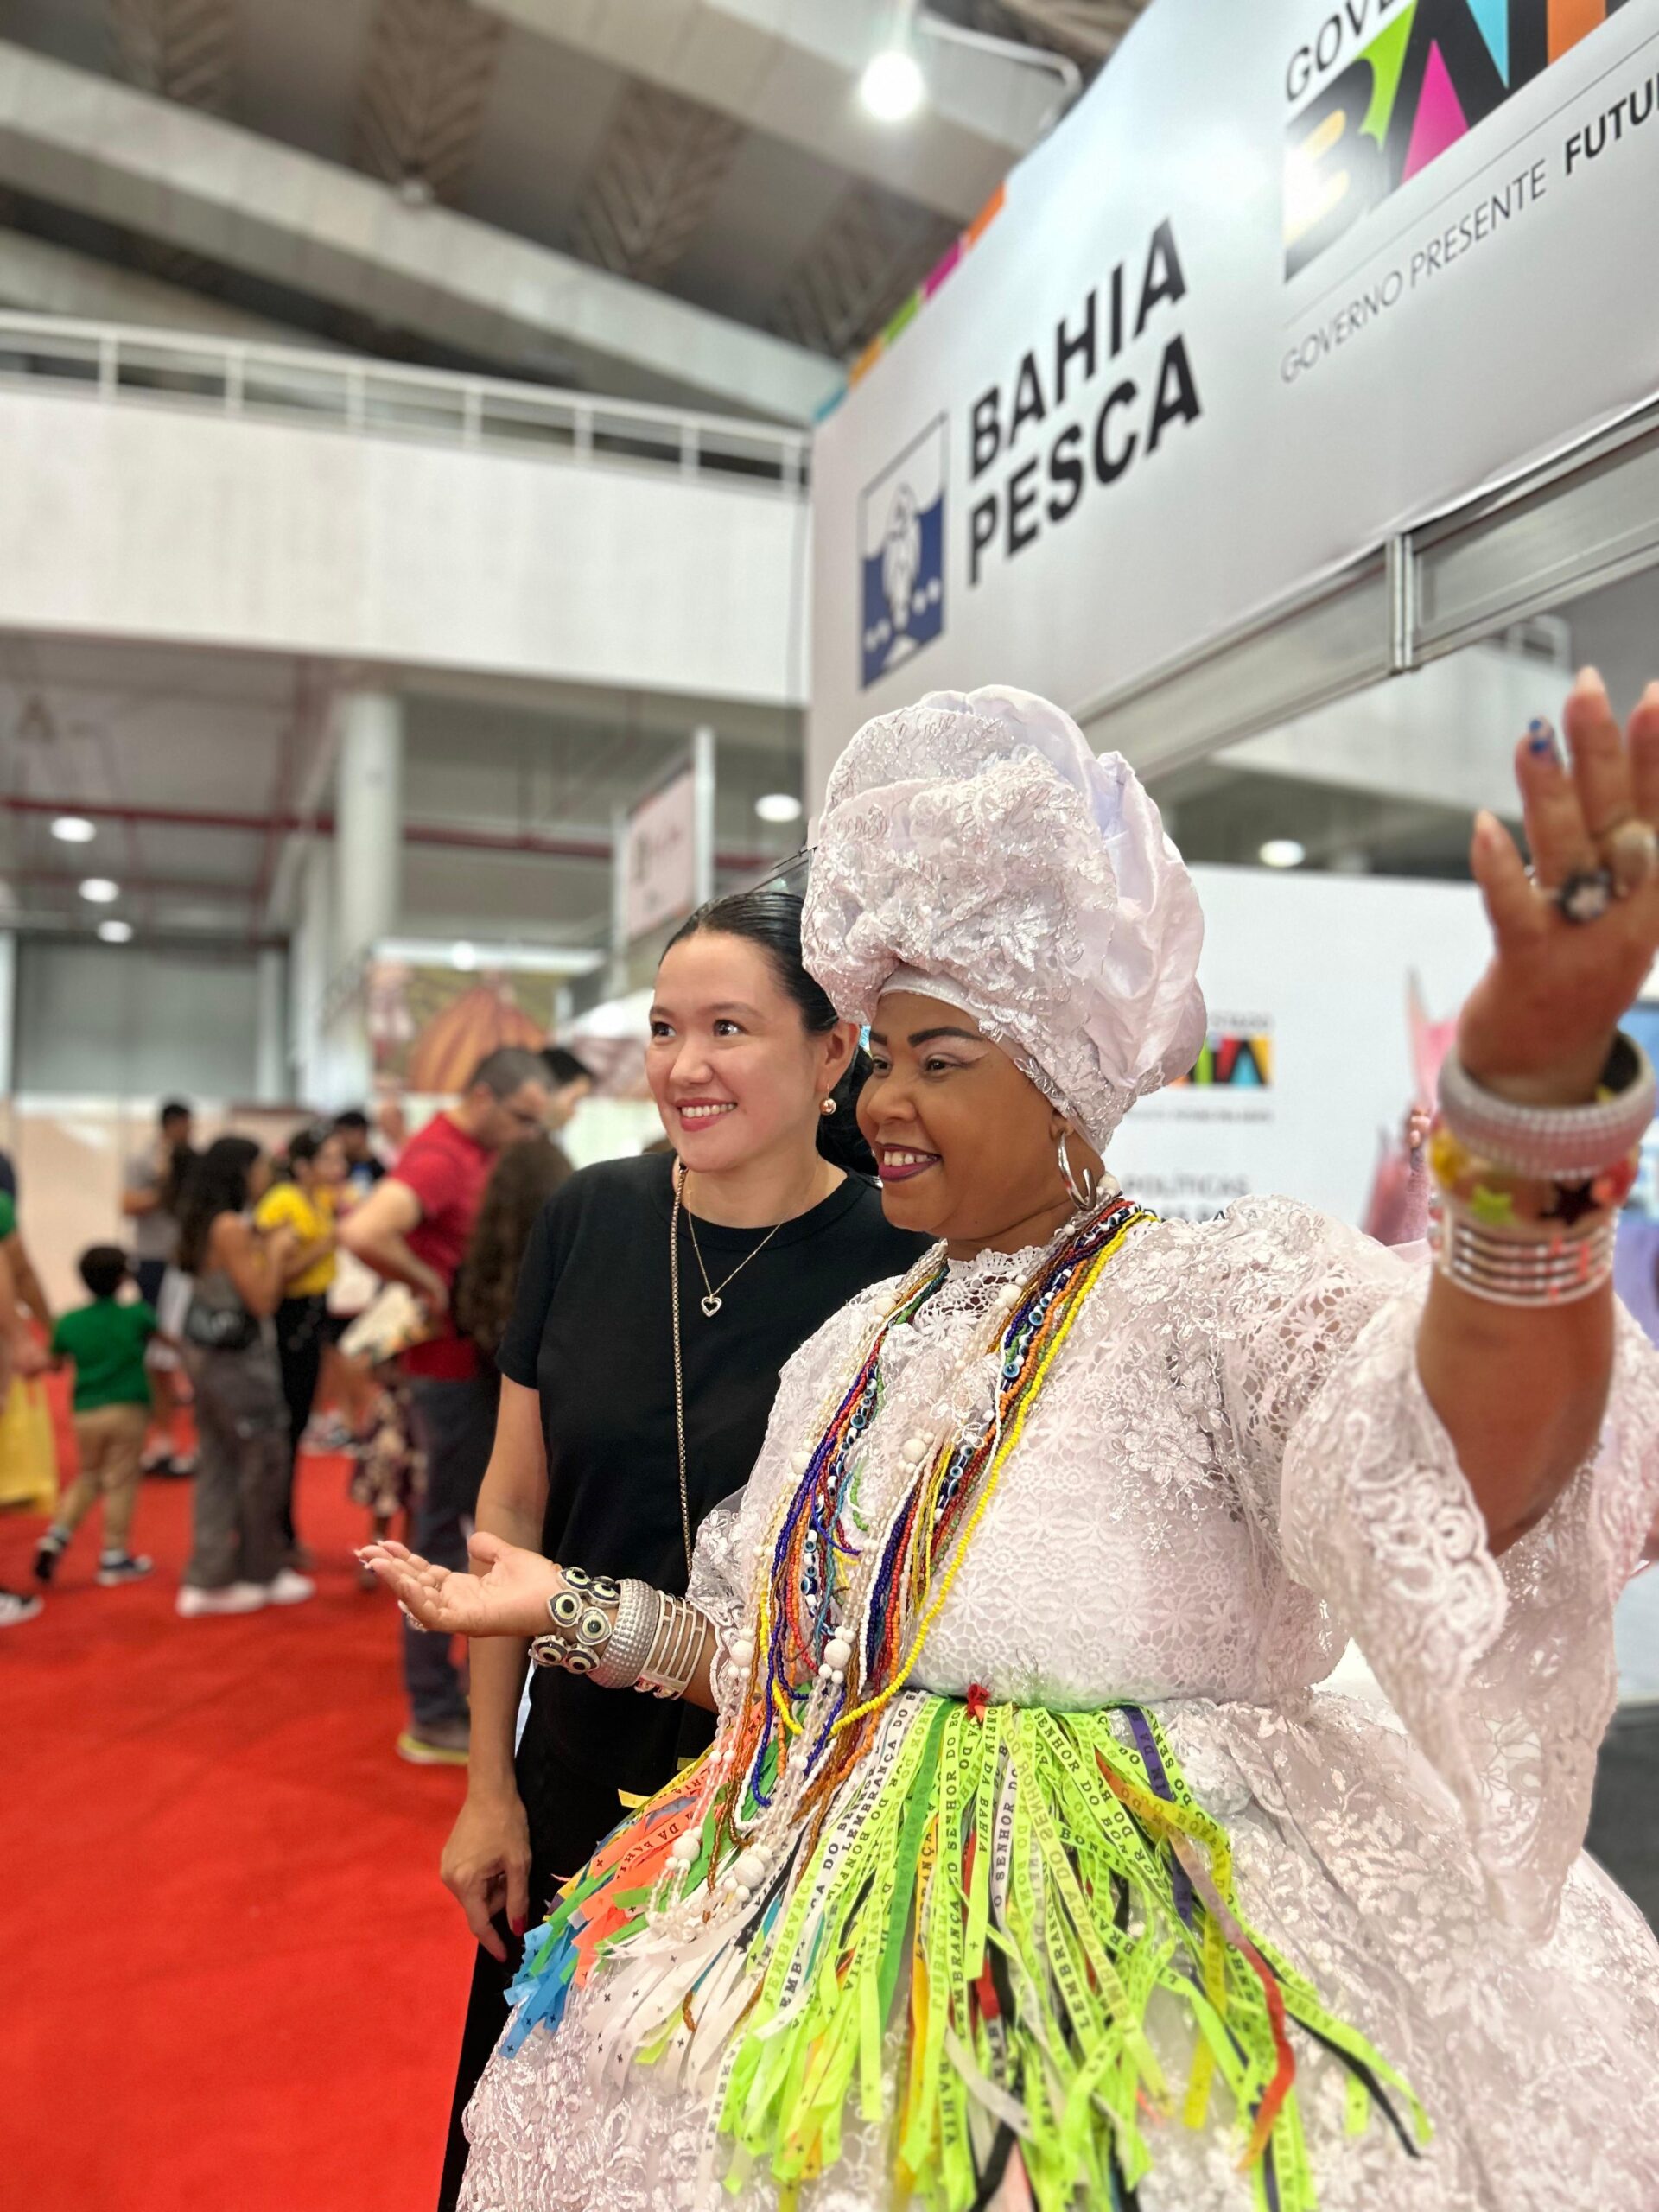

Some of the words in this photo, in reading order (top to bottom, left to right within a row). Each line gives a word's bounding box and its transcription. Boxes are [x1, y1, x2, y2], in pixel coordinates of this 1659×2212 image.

[1280, 270, 1404, 384] GOVERNO
[1409, 158, 1547, 289] PRESENTE
[1564, 71, 1659, 176] FUTU
[969, 216, 1187, 485] BAHIA
[969, 332, 1203, 589] PESCA
[945, 1737, 957, 1761] DO
[958, 1745, 974, 1770] DO
[982, 1761, 994, 1786] DA
[1033, 1711, 1080, 1773] SENHOR
[1080, 1779, 1100, 1806] DO
[841, 1739, 897, 1853] LEMBRANÇA
[893, 1709, 908, 1729] DO
[658, 1822, 680, 1841] DA
[978, 1796, 990, 1853] BAHIA
[995, 1802, 1015, 1881] SENHOR
[1114, 1811, 1135, 1838] DO
[823, 1842, 839, 1871] DO
[826, 1832, 870, 1901] BONFIM
